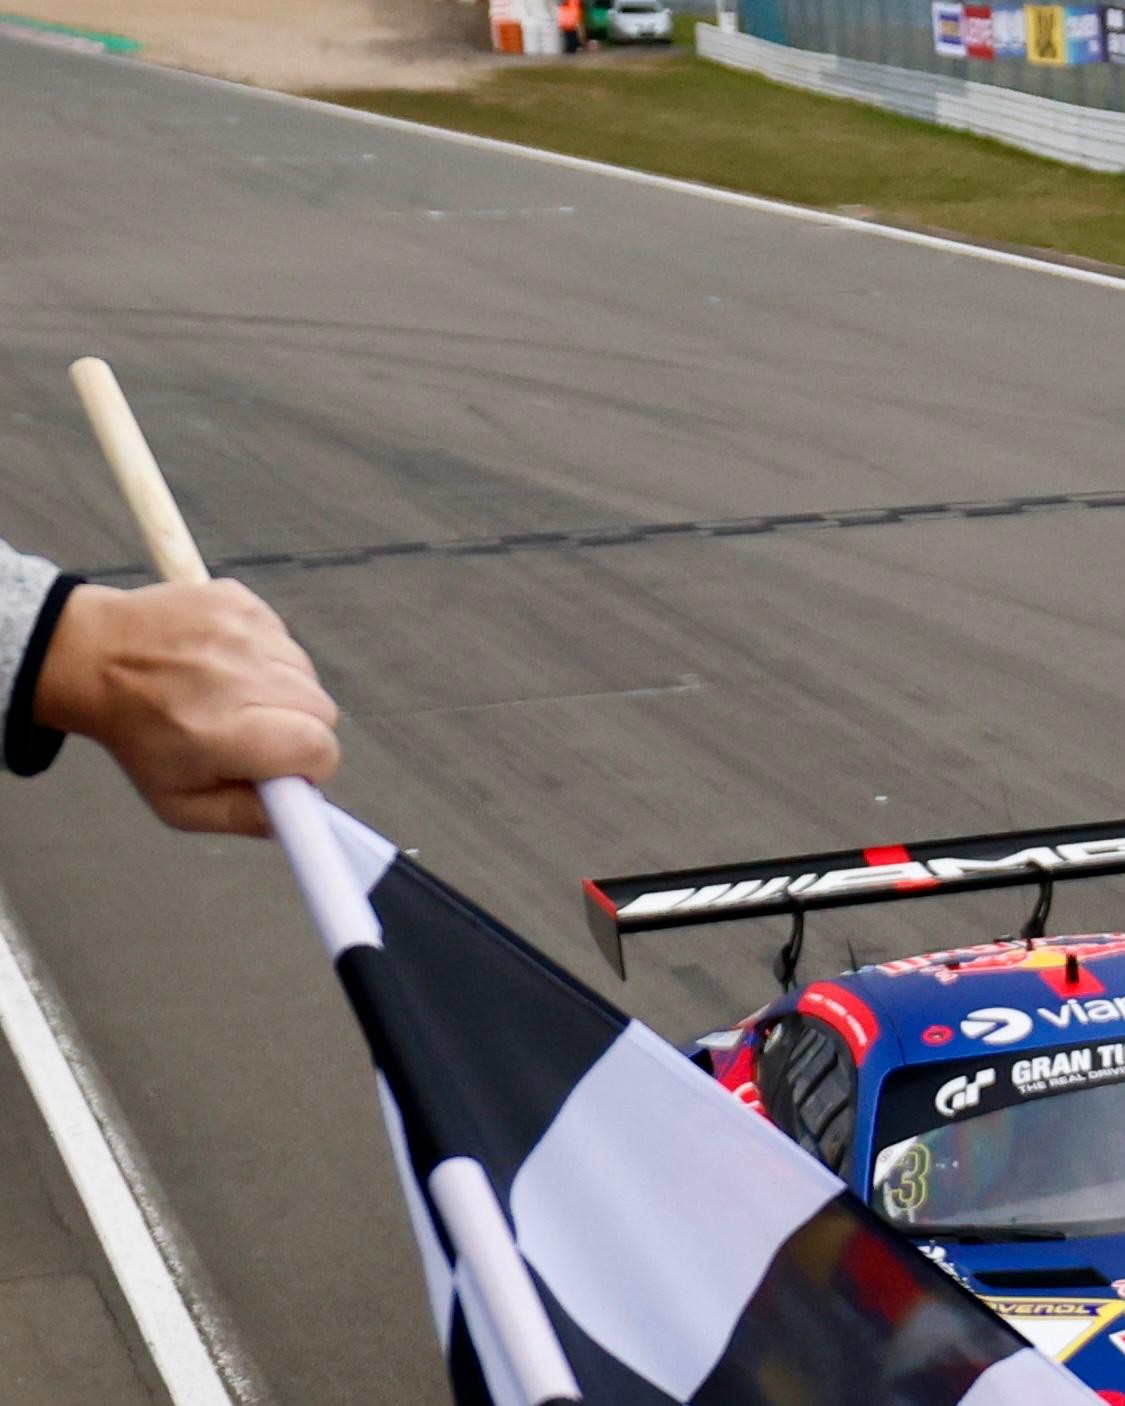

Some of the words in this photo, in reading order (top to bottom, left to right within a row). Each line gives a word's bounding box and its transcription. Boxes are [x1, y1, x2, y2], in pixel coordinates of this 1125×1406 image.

[1011, 1055, 1092, 1086] GRAN
[1017, 1082, 1048, 1096] THE
[1049, 1073, 1087, 1088] REAL
[887, 1143, 931, 1213] 3
